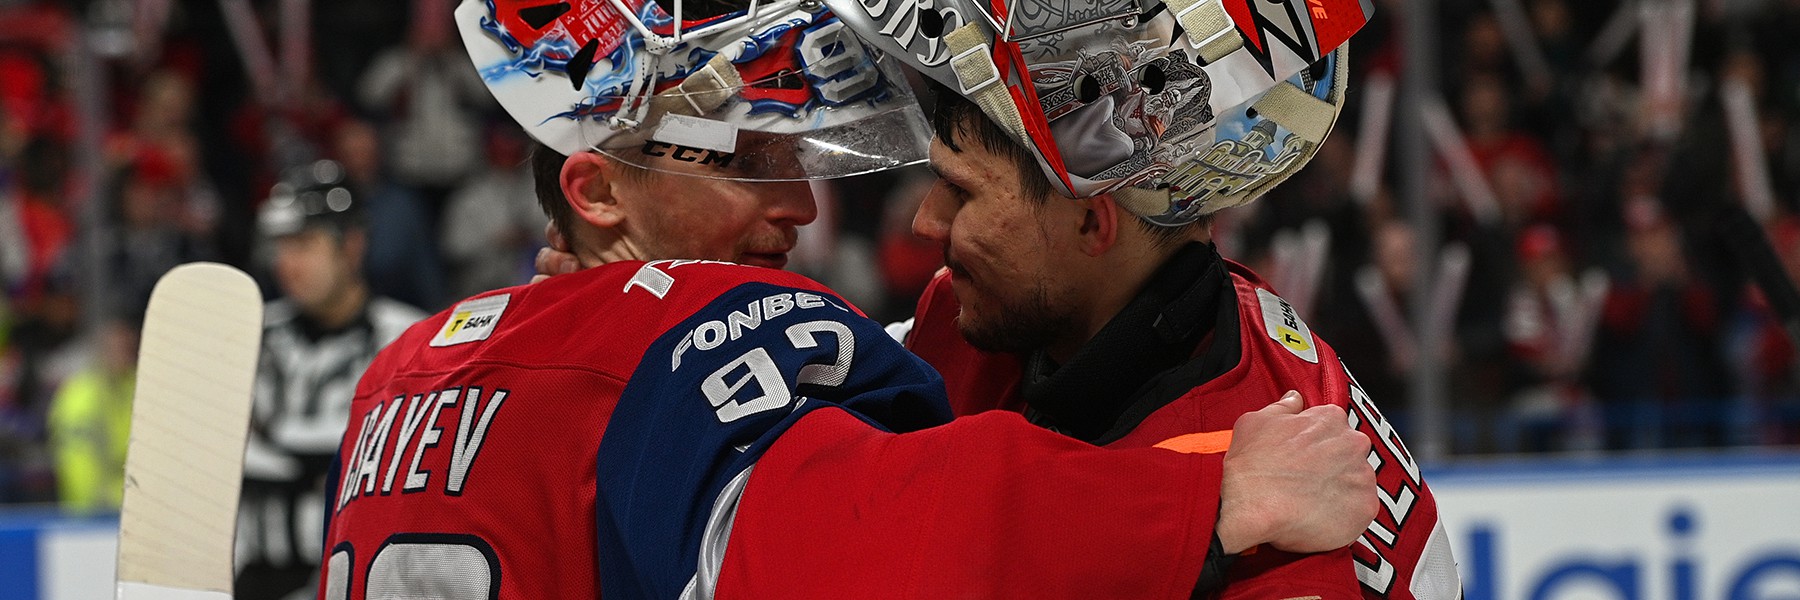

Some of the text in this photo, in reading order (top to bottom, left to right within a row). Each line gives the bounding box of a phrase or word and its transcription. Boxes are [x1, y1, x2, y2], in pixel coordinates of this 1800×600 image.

[641, 139, 736, 168] CCM
[671, 291, 849, 372] FONBE
[700, 320, 855, 423] 92
